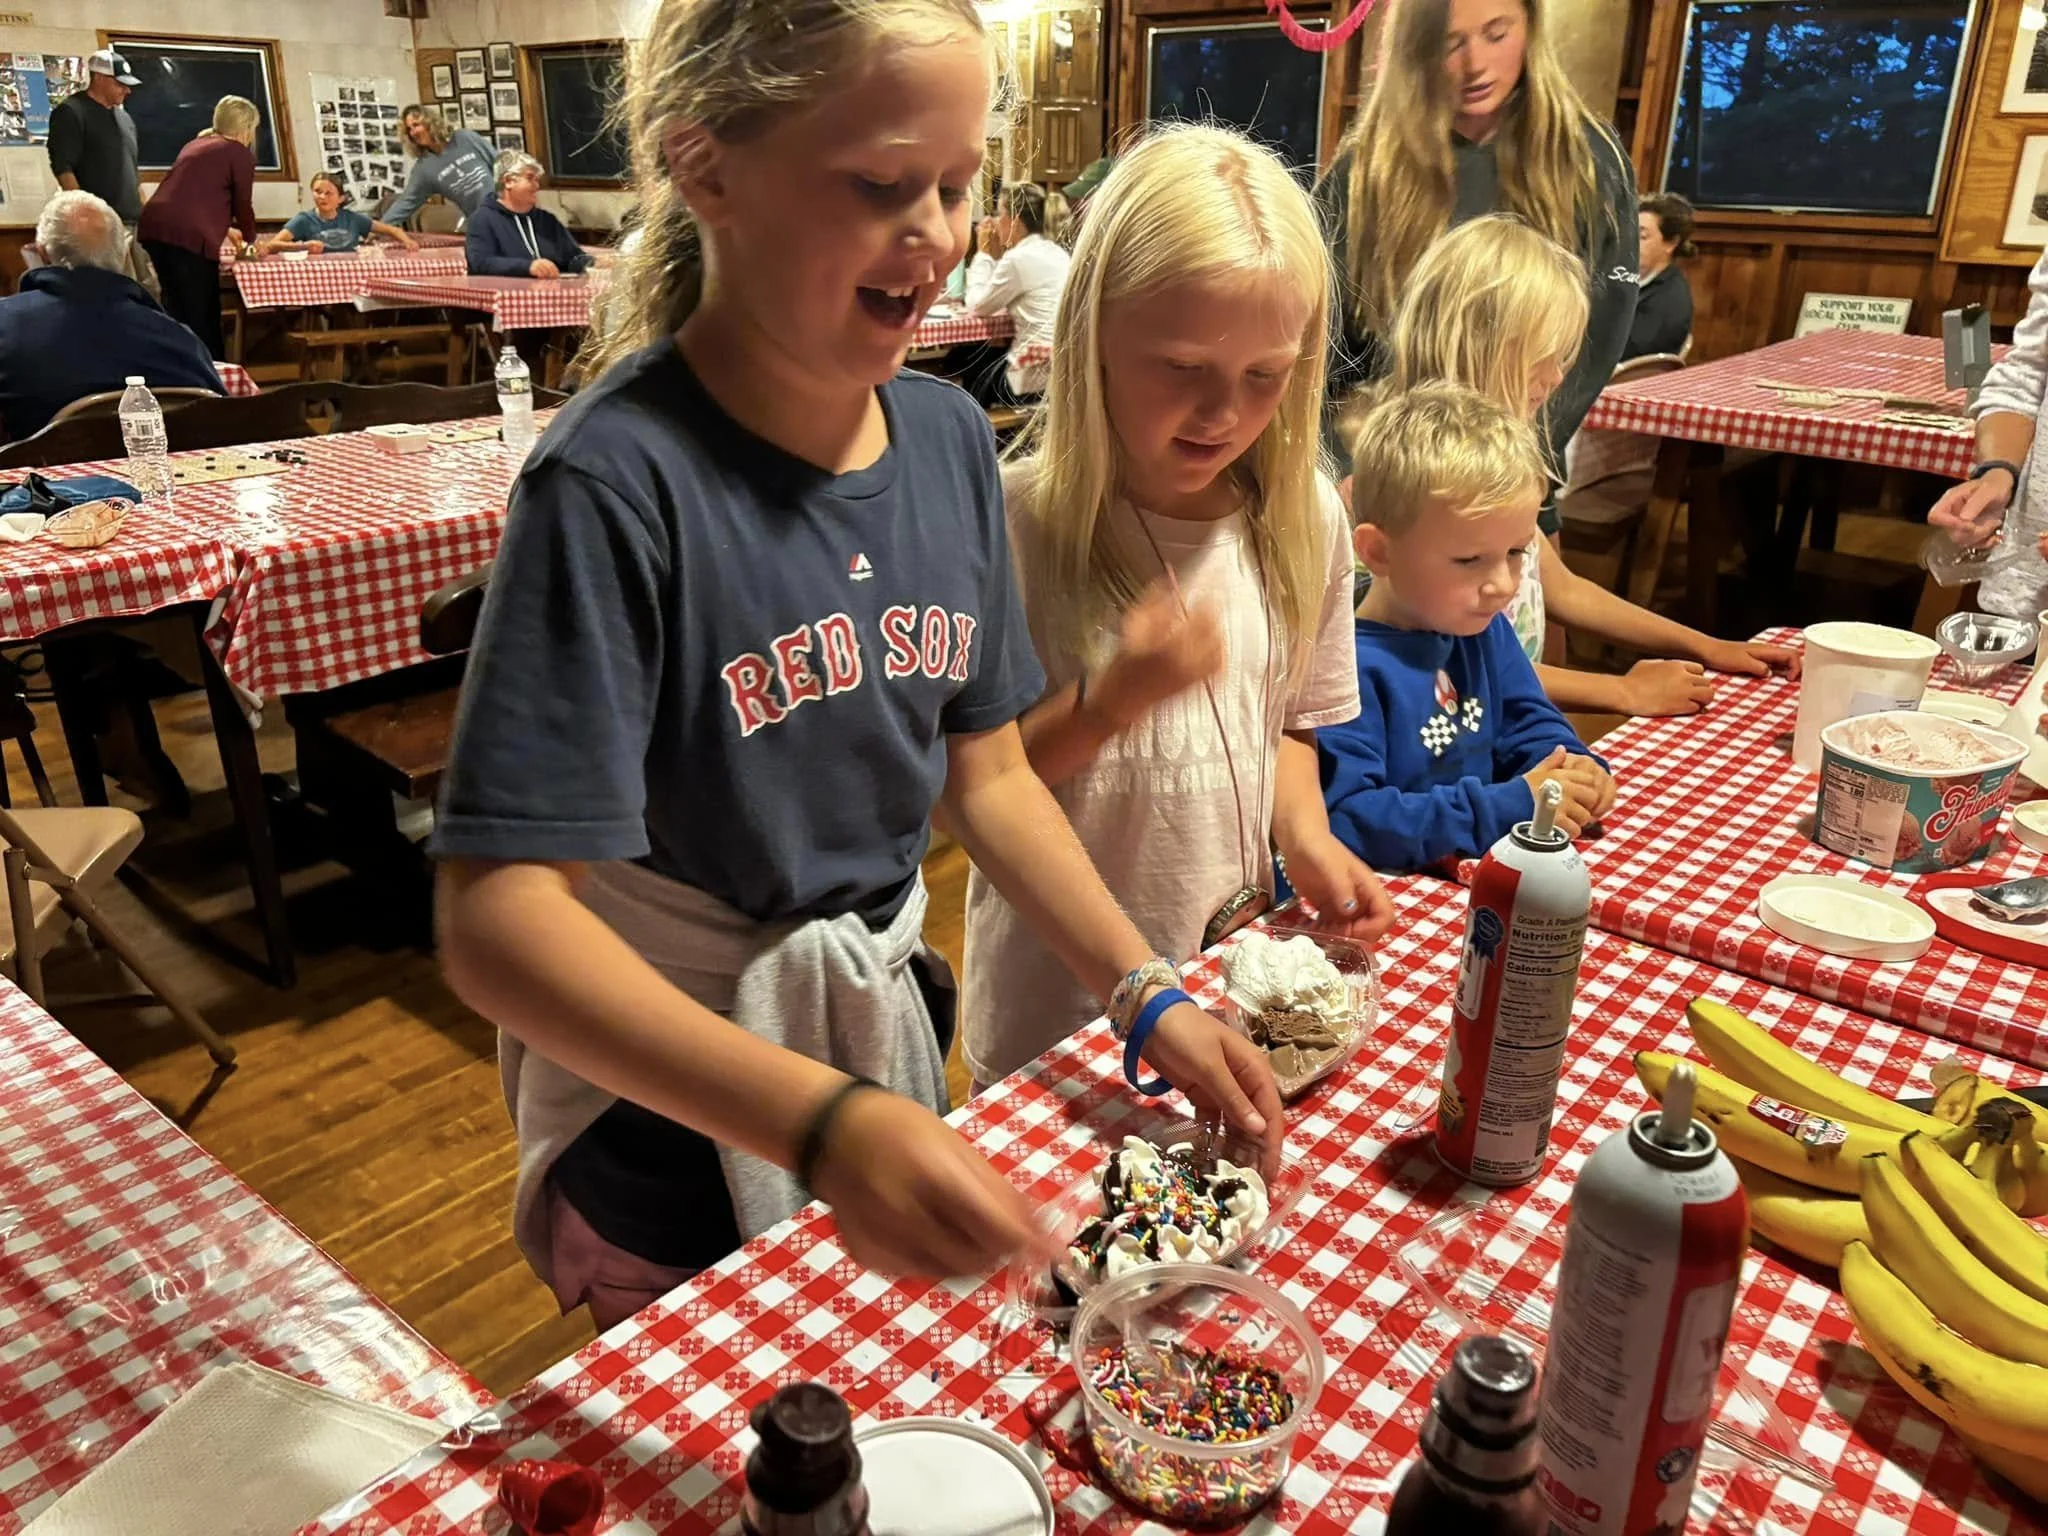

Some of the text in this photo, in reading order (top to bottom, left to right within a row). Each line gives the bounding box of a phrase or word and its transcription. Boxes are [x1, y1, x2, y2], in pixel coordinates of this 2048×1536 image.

[1820, 300, 1895, 313] SUPPORT YOUR
[1804, 309, 1902, 325] LOCAL SNOWMOBILE
[721, 605, 977, 737] RED SOX
[1512, 928, 1568, 942] Nutrition
[1506, 961, 1553, 973] Calories
